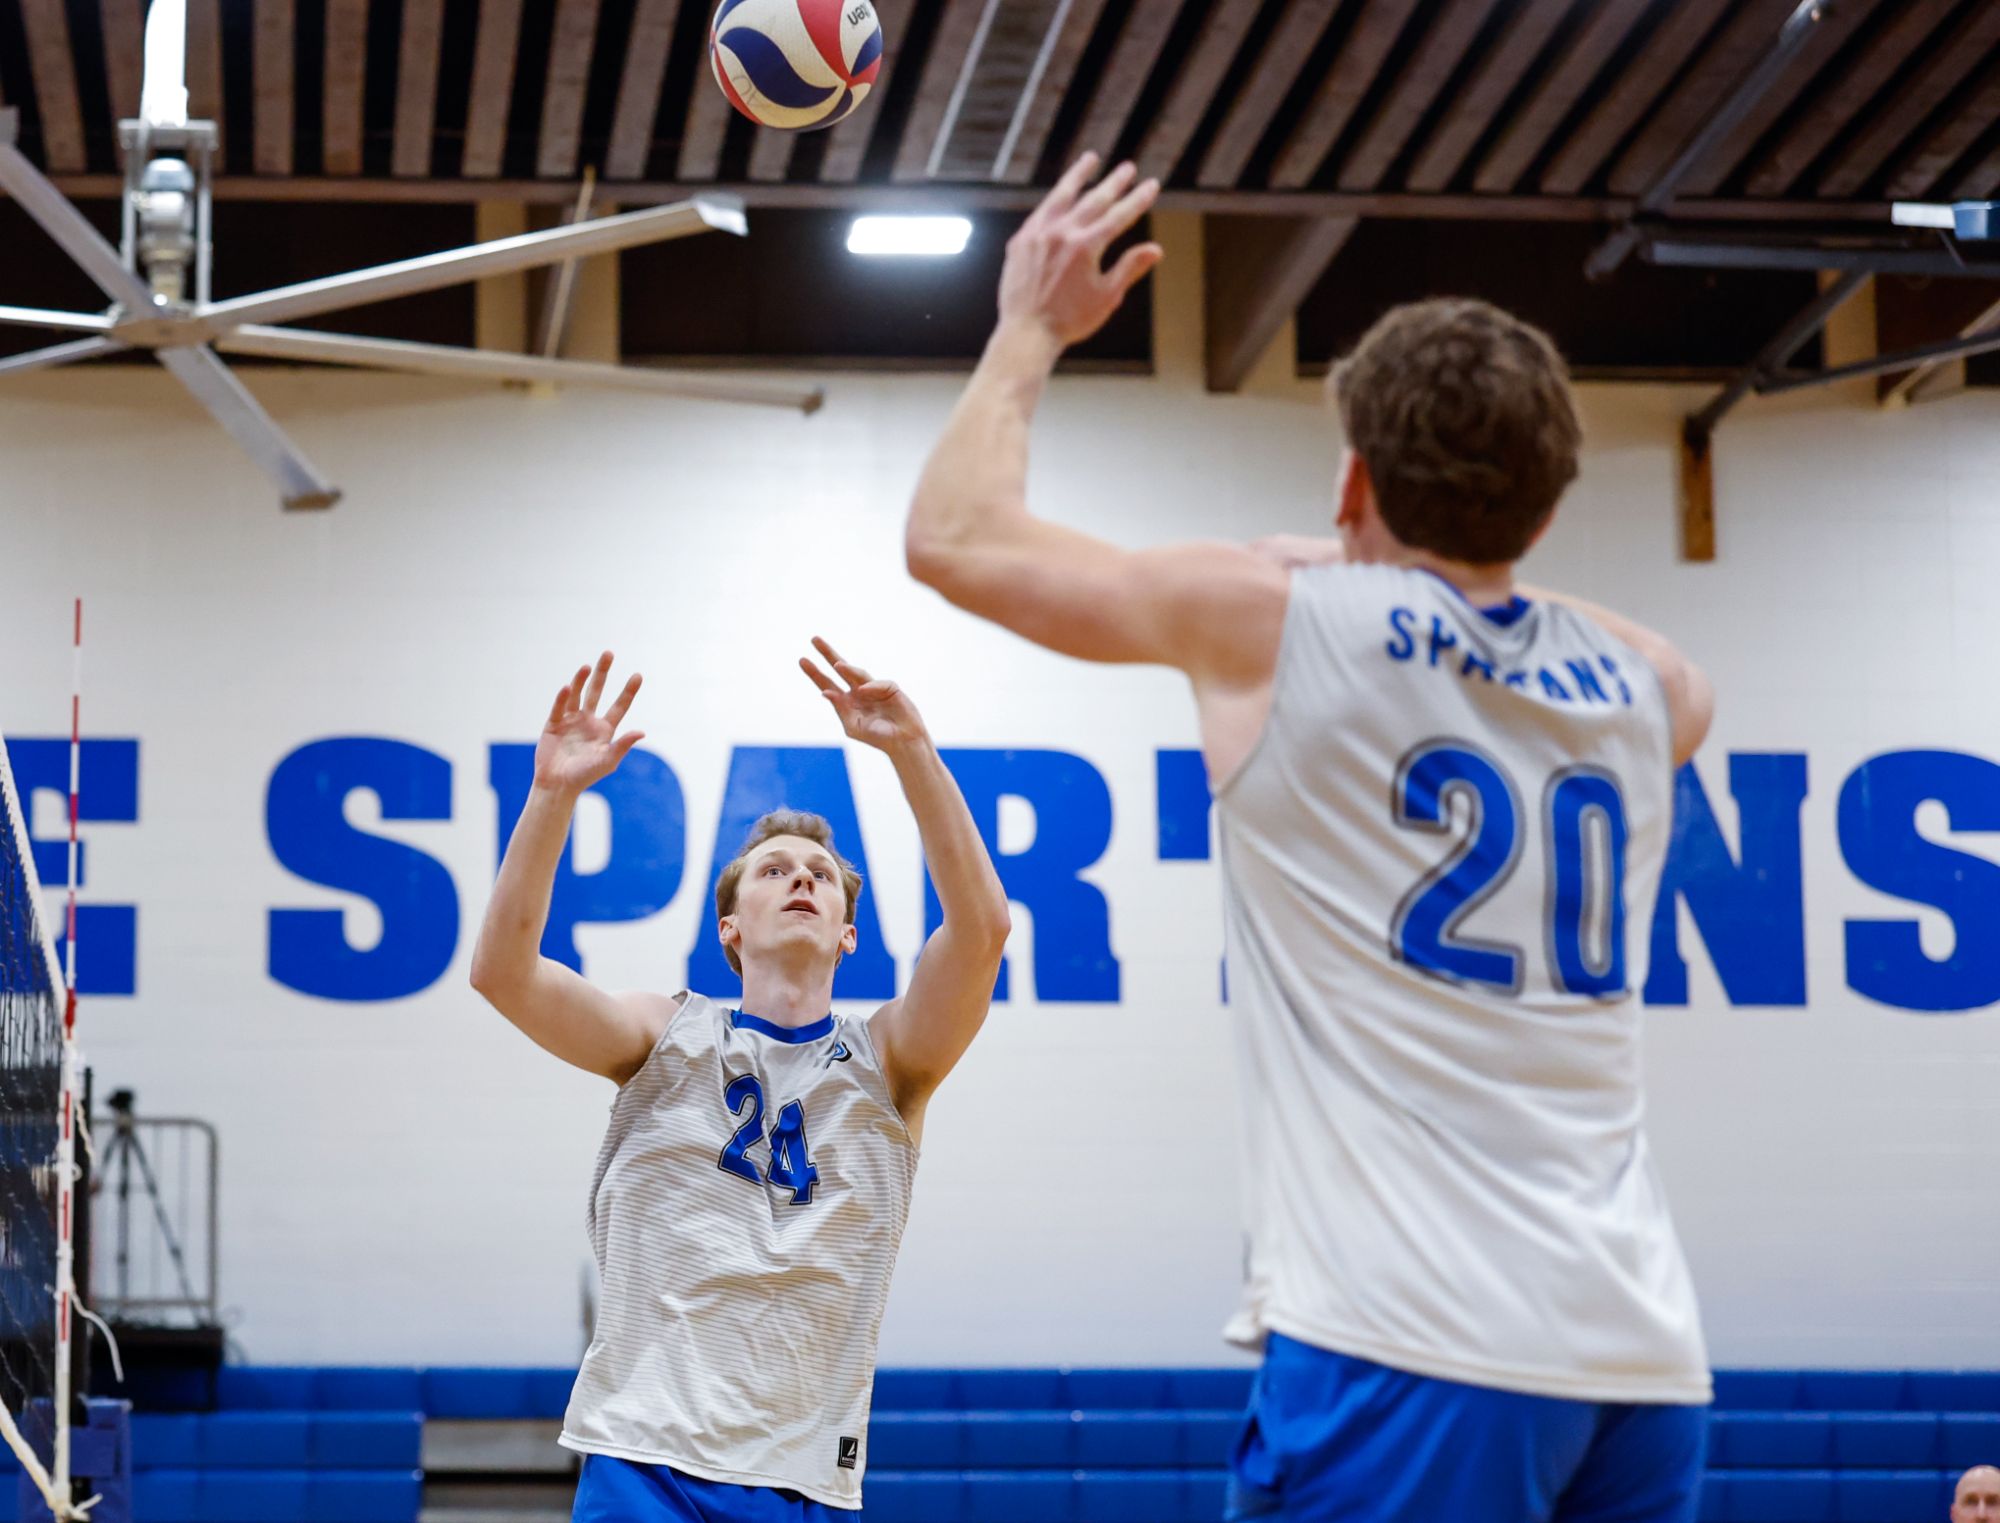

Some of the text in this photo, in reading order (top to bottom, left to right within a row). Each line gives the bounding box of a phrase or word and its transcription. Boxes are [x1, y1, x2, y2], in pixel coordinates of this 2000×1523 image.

[264, 735, 2000, 1013] SPARNS
[1388, 735, 1633, 1005] 20
[717, 1072, 820, 1206] 24
